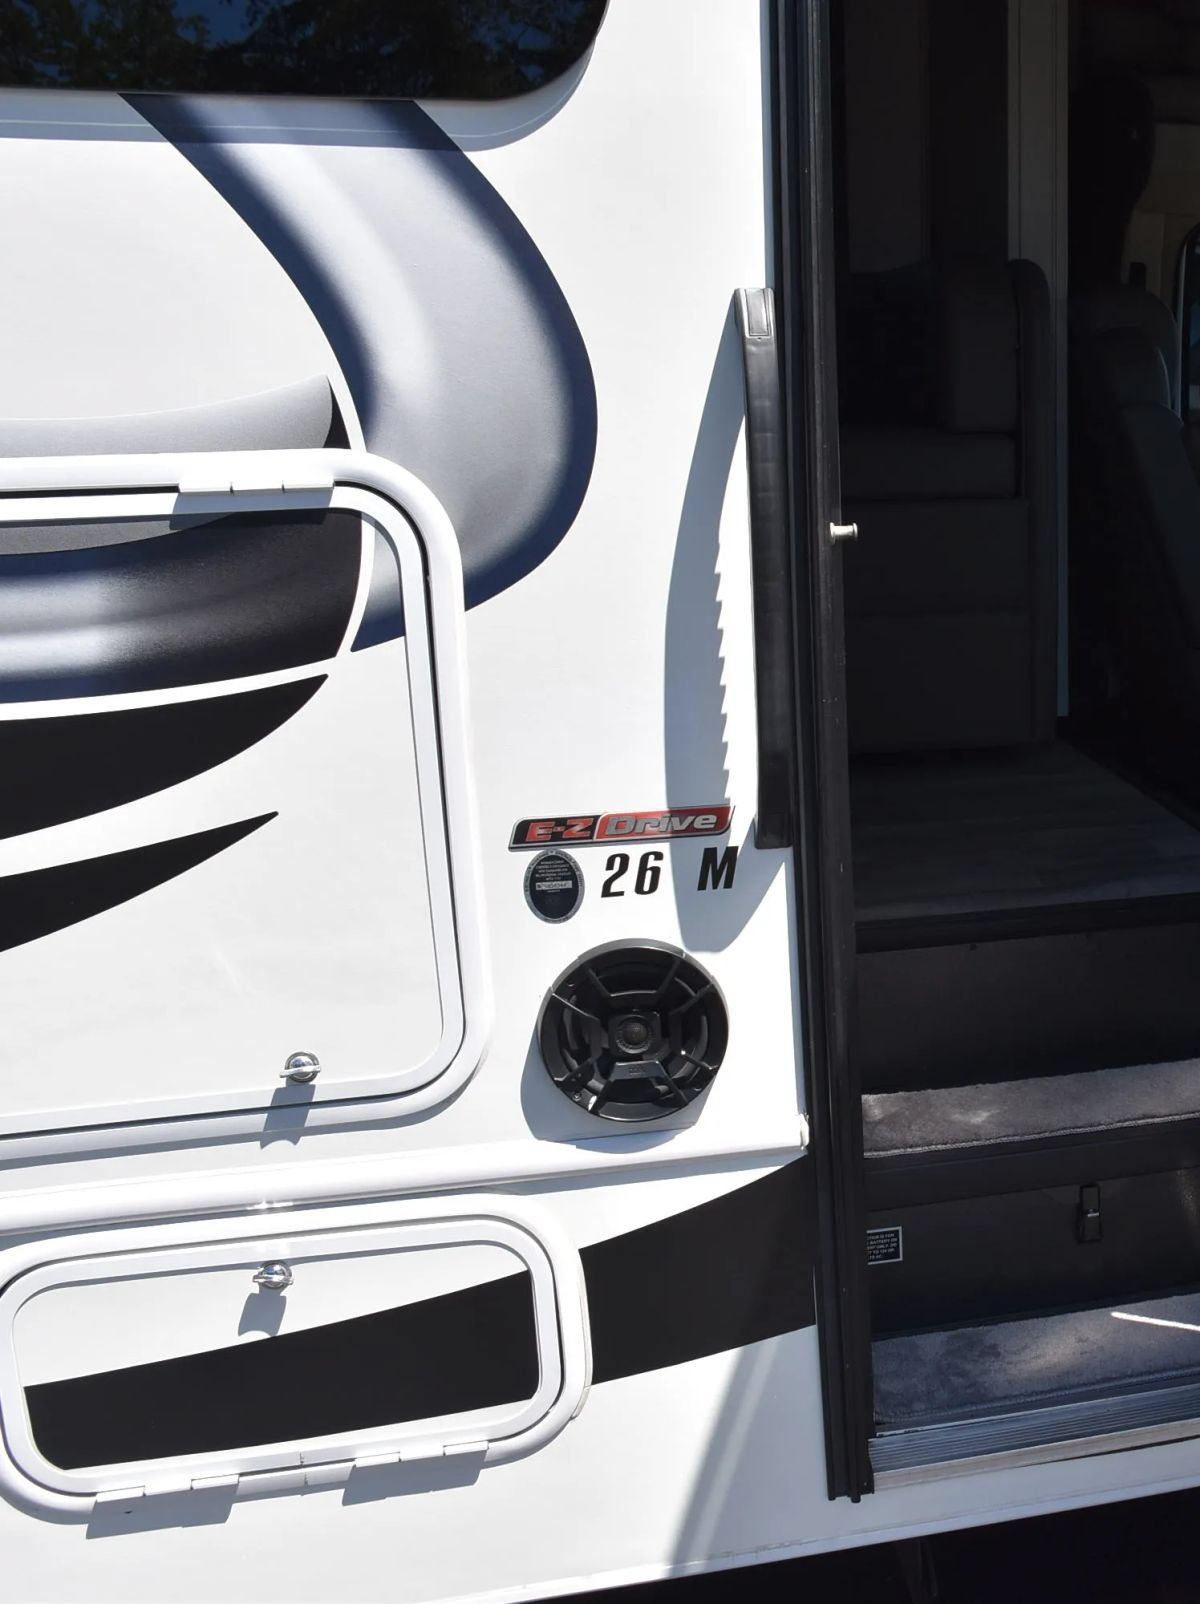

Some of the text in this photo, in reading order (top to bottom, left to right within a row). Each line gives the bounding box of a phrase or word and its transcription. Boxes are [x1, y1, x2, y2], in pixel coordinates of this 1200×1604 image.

[525, 814, 718, 842] E-Z Drive
[601, 851, 664, 898] 26
[697, 846, 739, 891] M
